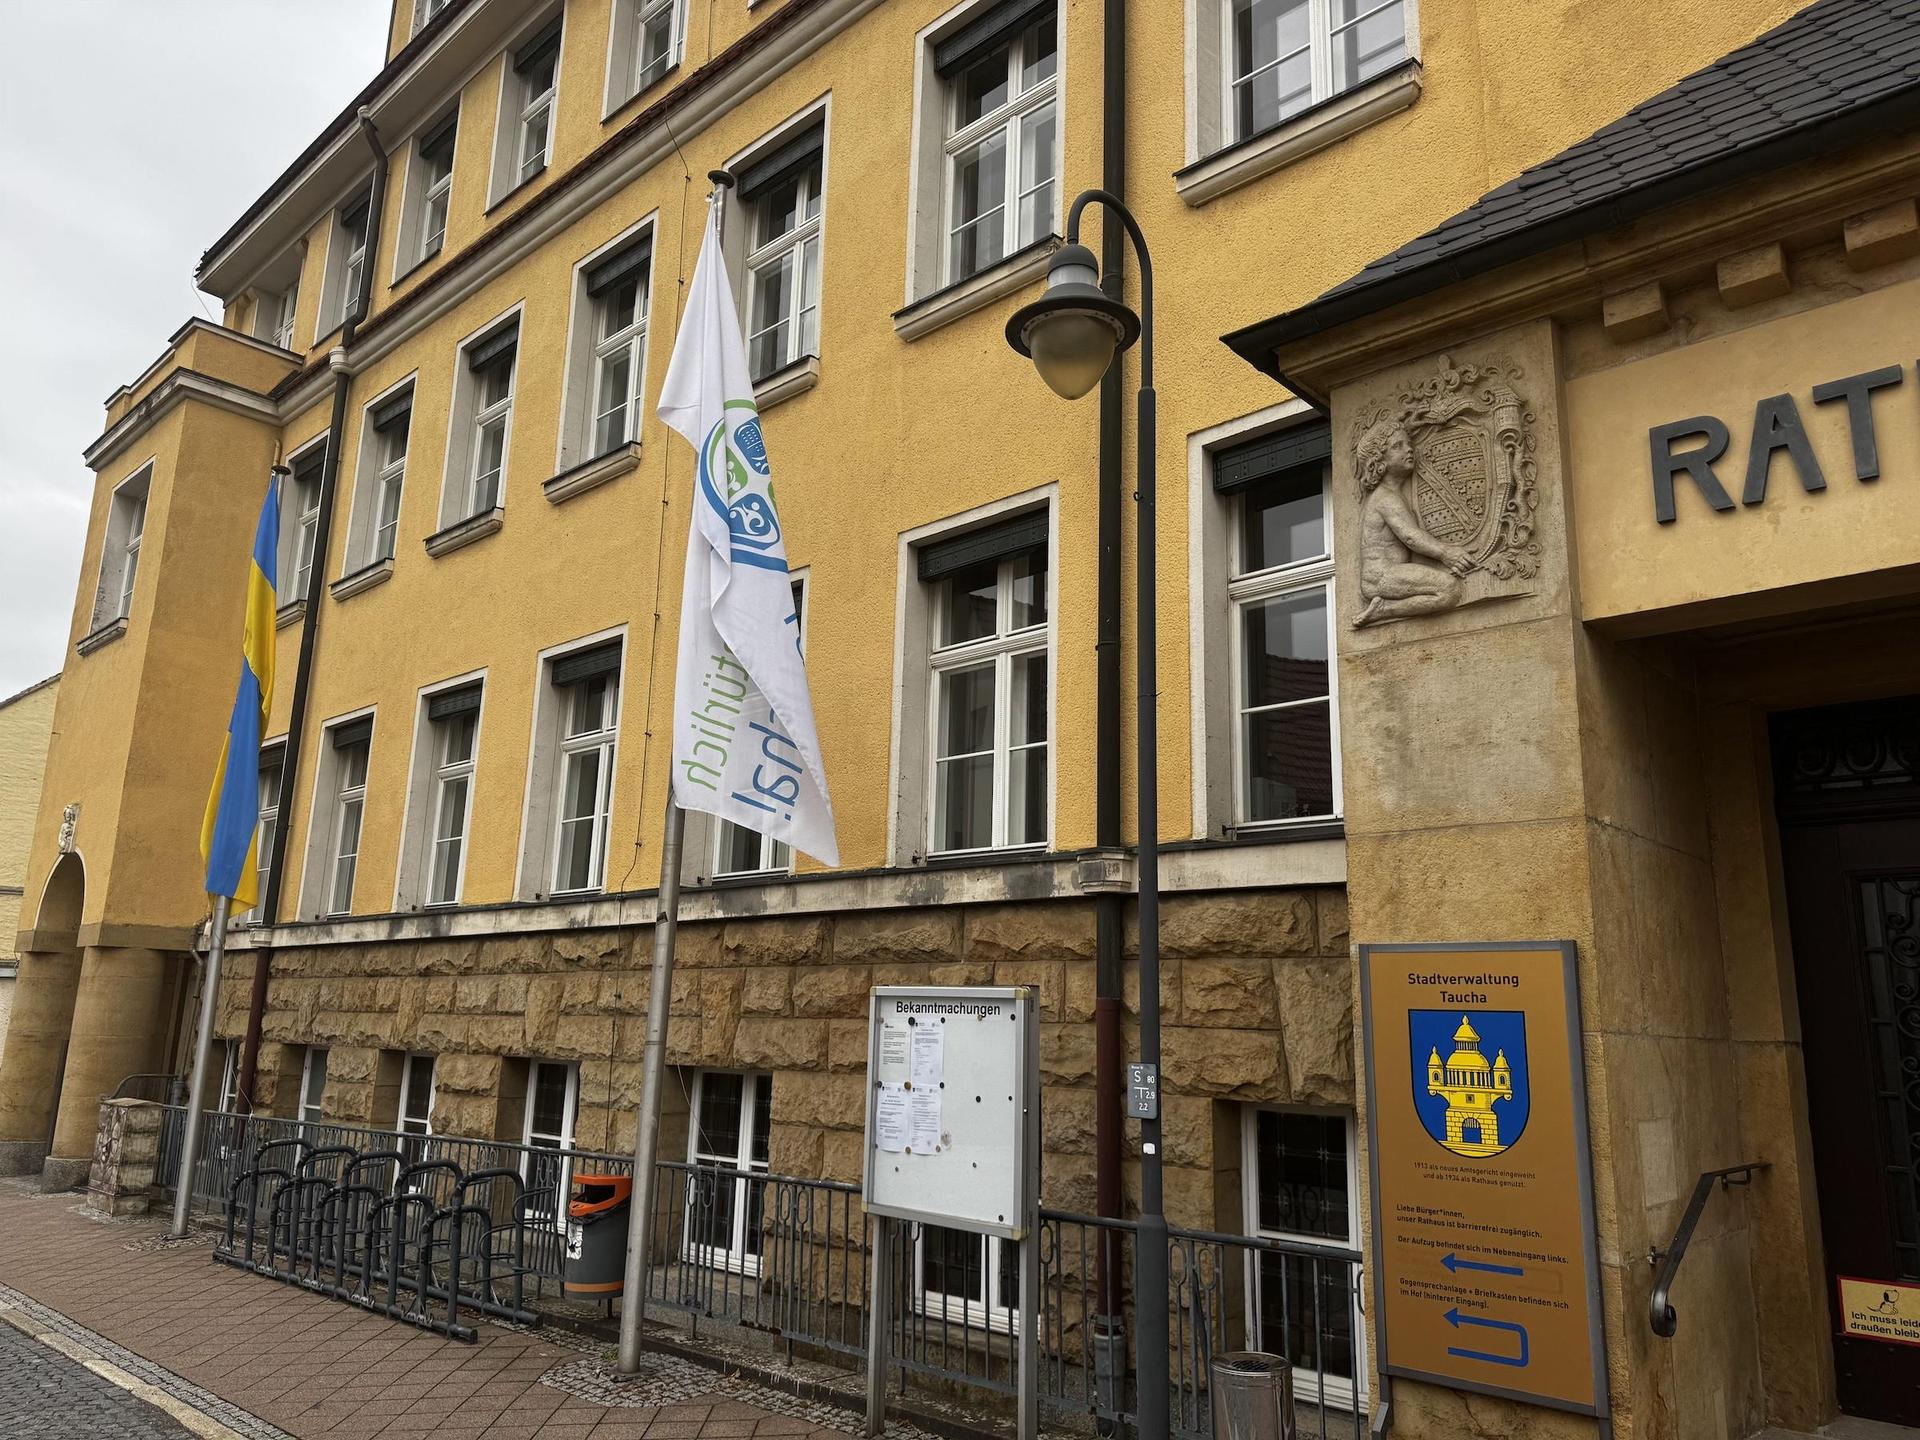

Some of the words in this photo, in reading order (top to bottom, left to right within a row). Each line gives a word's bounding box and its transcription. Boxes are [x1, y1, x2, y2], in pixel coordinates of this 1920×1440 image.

[1649, 359, 1920, 525] RAT
[1408, 973, 1519, 987] Stadtverwaltung
[1440, 991, 1487, 1003] Taucha
[896, 1001, 1000, 1017] Bekanntmachungen
[1134, 1071, 1141, 1082] S
[1146, 1091, 1155, 1100] 2.9
[1139, 1103, 1148, 1111] 2.2
[1414, 1162, 1428, 1170] 1913
[1460, 1167, 1498, 1177] Amtsgericht
[1500, 1170, 1536, 1180] eingeweiht
[1423, 1172, 1434, 1180] und
[1472, 1176, 1498, 1186] Rathaus
[1499, 1180, 1526, 1188] genutzt.
[1396, 1204, 1415, 1212] Liebe
[1397, 1215, 1416, 1223] unser
[1418, 1216, 1445, 1226] Rathaus
[1446, 1220, 1455, 1228] ist
[1456, 1221, 1499, 1233] barrierefrei
[1500, 1227, 1542, 1239] zugänglich.
[1397, 1235, 1410, 1243] Der
[1411, 1237, 1435, 1248] Aufzug
[1436, 1240, 1465, 1250] befindet
[1466, 1244, 1480, 1252] sich
[1482, 1246, 1492, 1254] im
[1493, 1247, 1546, 1262] Nebeneingang
[1547, 1253, 1569, 1264] links.
[1399, 1277, 1467, 1295] Gegensprechanlage
[1474, 1288, 1517, 1302] Briefkasten
[1518, 1295, 1552, 1307] befinden
[1553, 1301, 1569, 1309] sich
[1400, 1288, 1409, 1296] im
[1410, 1290, 1422, 1298] Hof
[1423, 1291, 1455, 1303] (hinterer
[1851, 1311, 1867, 1321] Ich
[1869, 1315, 1897, 1325] muss
[1850, 1321, 1892, 1335] draußen
